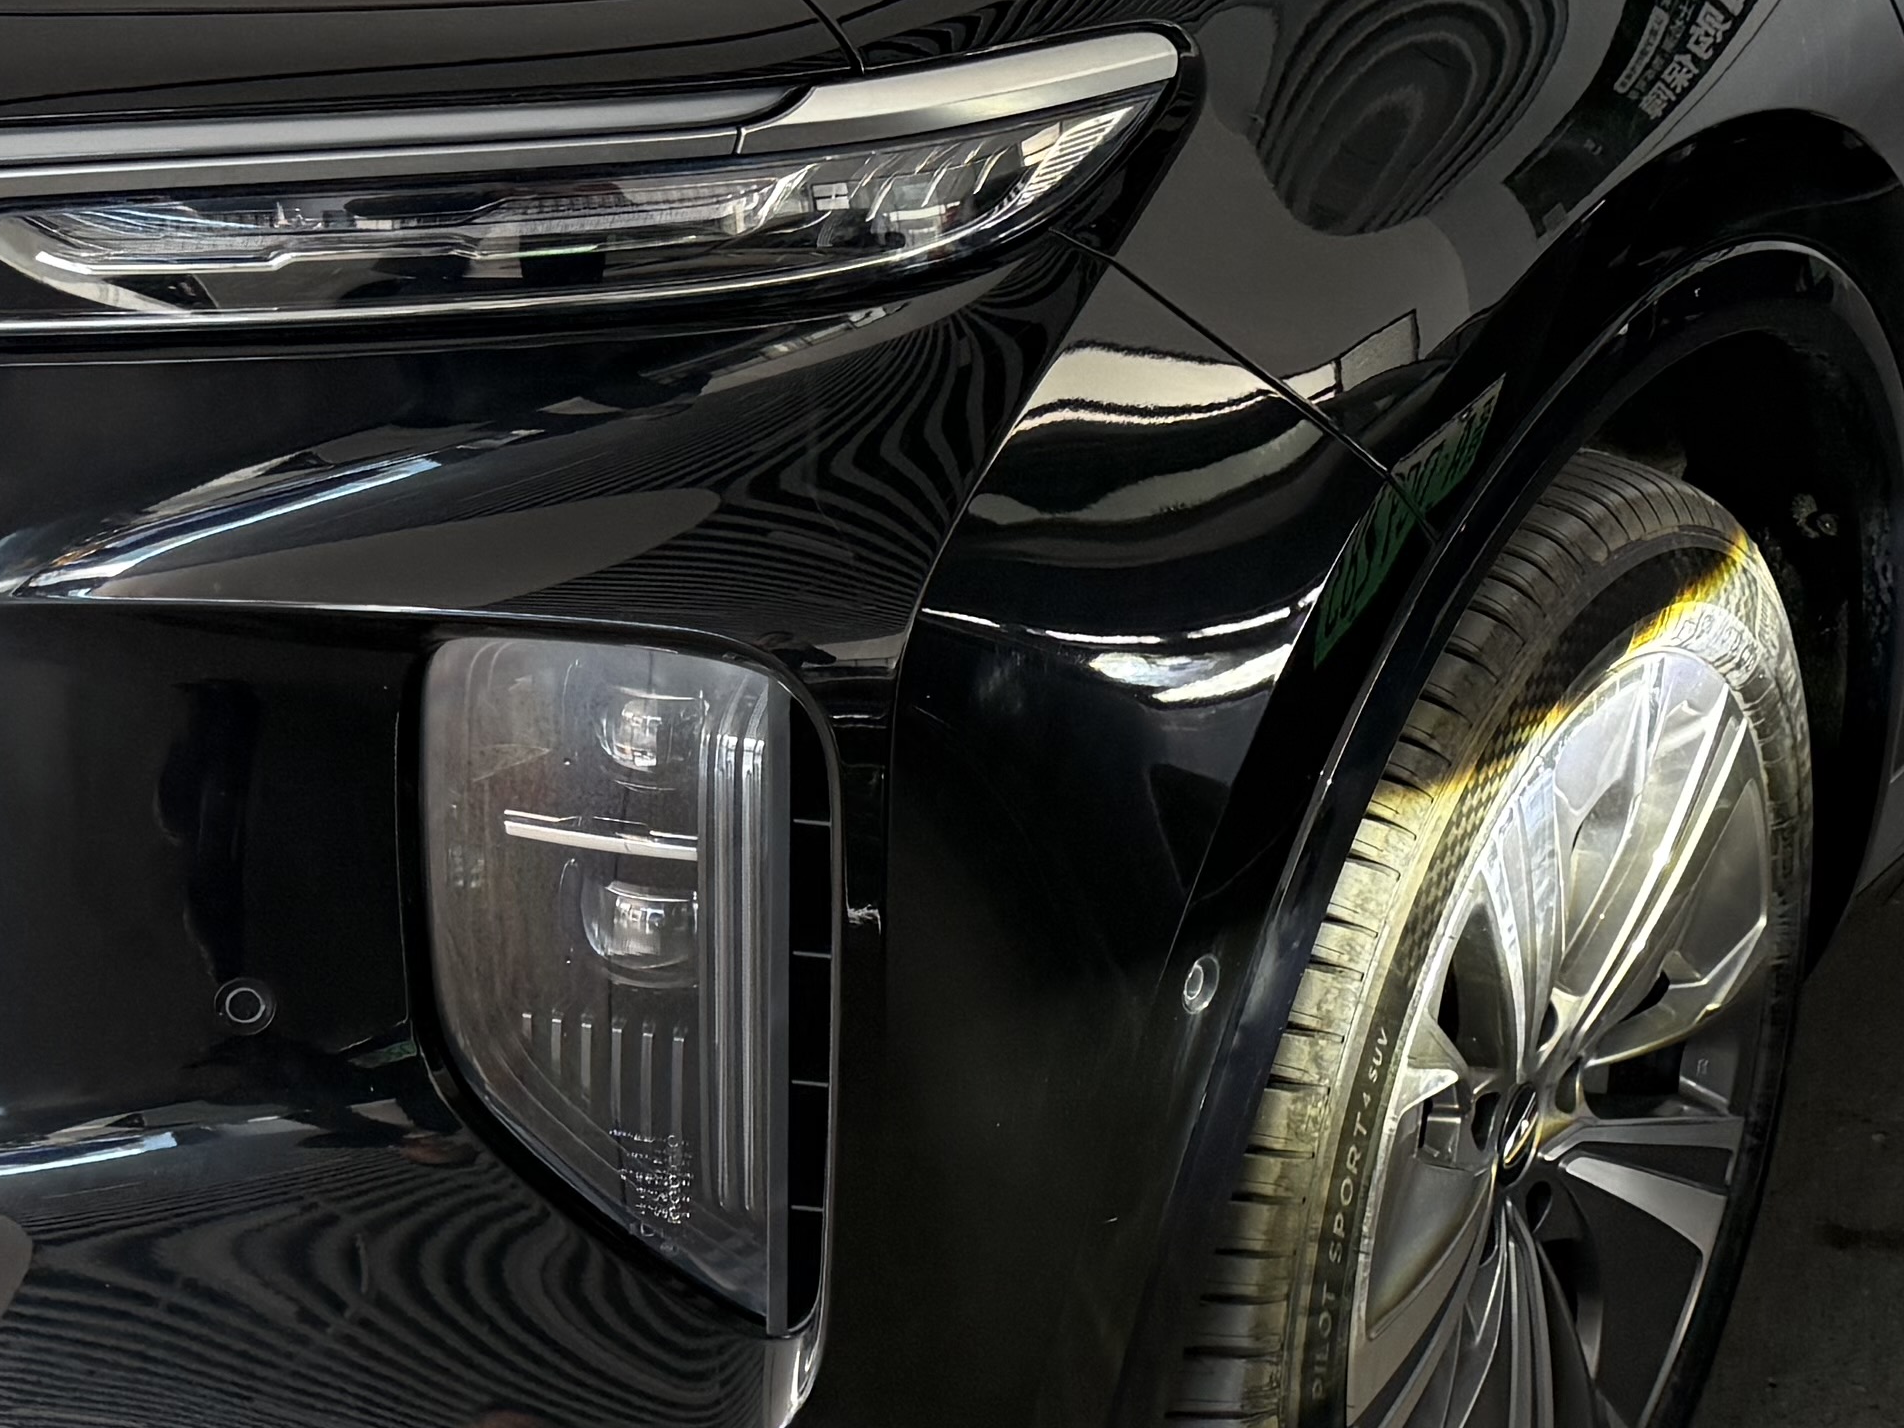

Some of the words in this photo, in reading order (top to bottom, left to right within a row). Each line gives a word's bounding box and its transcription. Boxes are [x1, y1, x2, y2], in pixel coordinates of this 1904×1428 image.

[1311, 1280, 1337, 1401] PILOT
[1329, 1111, 1368, 1264] SPORT
[1362, 1091, 1372, 1109] 4
[1368, 1026, 1389, 1084] SUV
